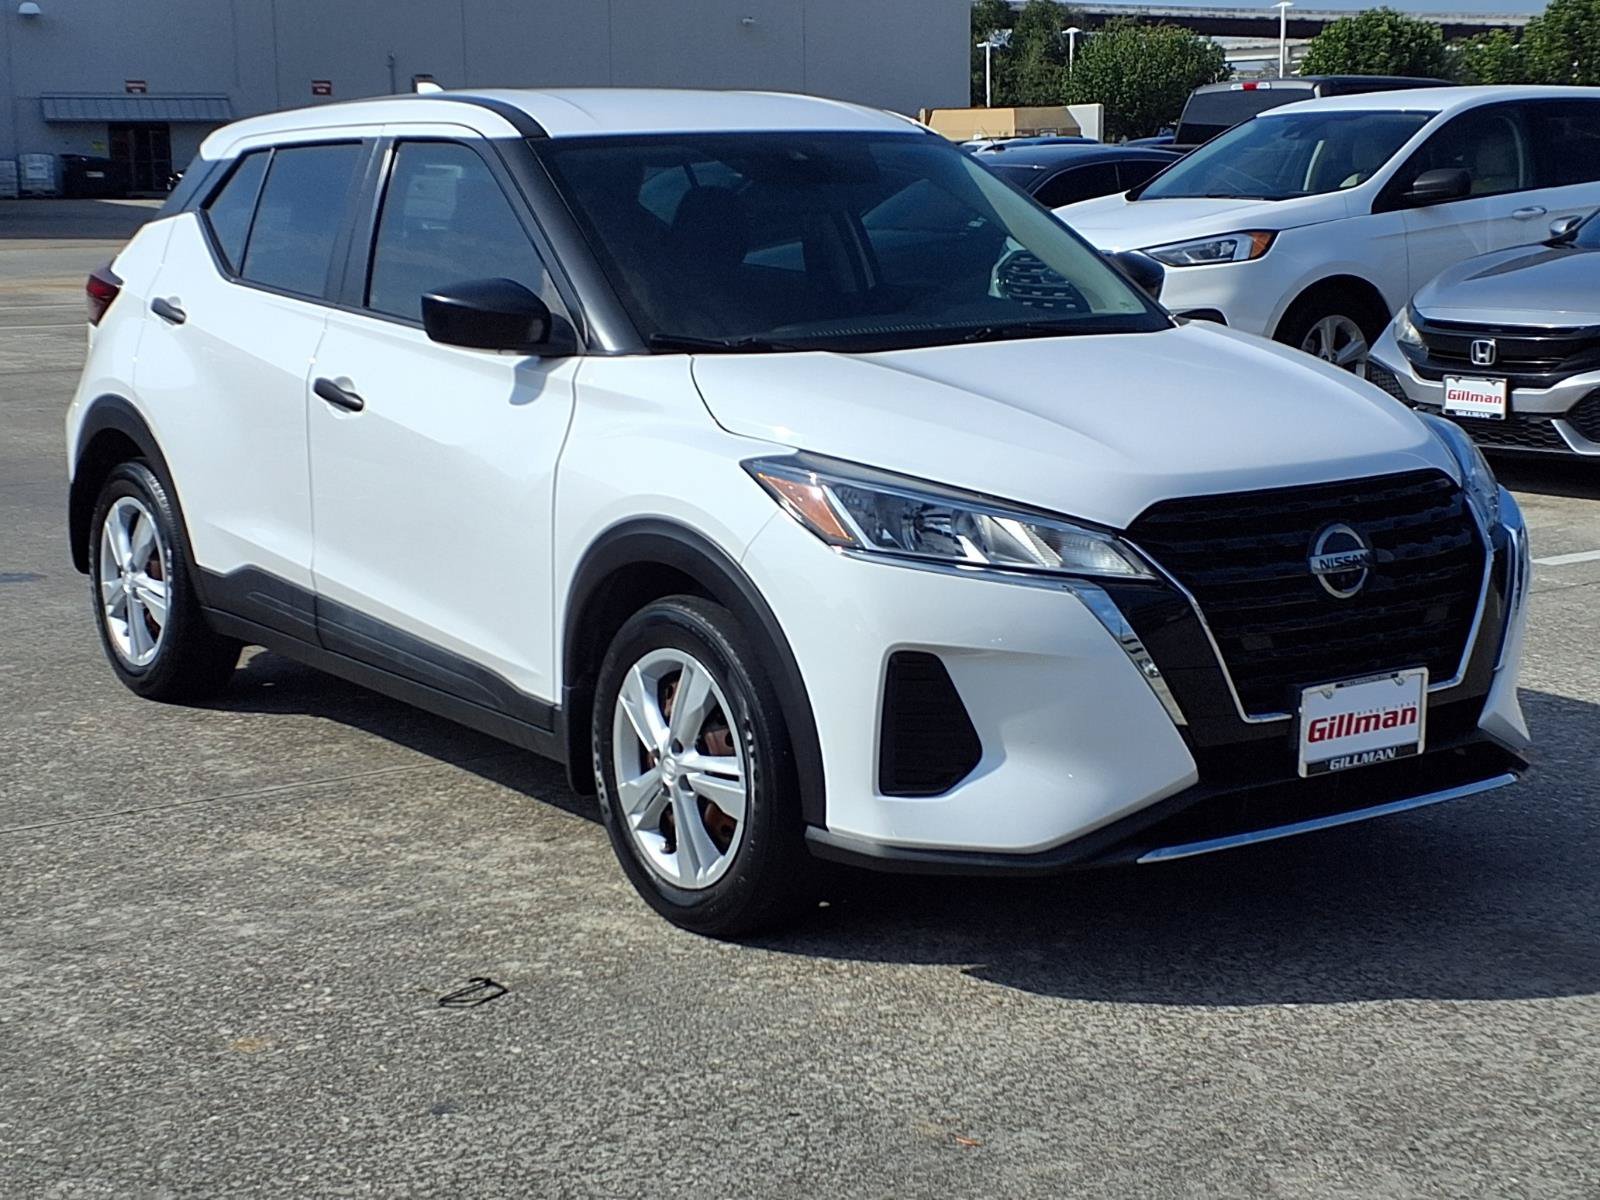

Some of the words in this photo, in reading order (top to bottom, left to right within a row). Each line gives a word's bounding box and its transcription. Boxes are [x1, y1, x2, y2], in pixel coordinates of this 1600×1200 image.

[1447, 389, 1502, 404] Gillman
[1319, 552, 1368, 569] NISSAN
[1307, 706, 1417, 743] Gillman
[1329, 747, 1397, 771] GILLMAN
